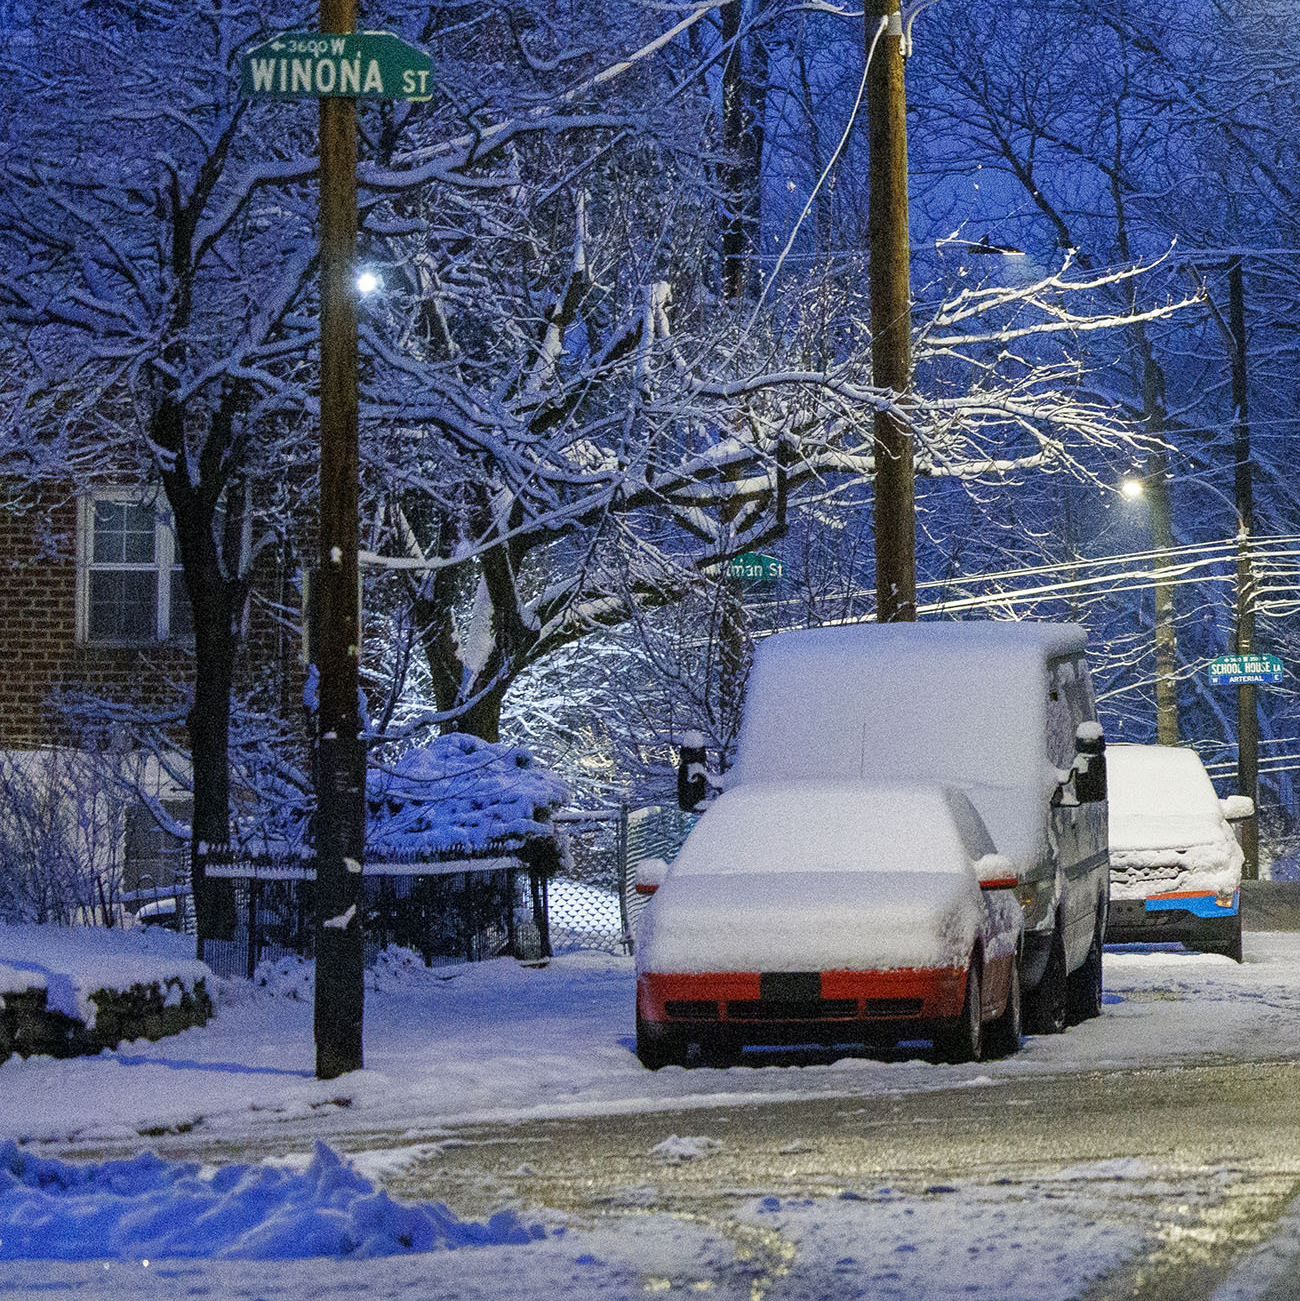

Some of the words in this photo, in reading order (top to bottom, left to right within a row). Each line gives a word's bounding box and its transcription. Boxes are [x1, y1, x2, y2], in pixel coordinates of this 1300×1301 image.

[330, 38, 346, 56] W
[250, 58, 384, 93] WINONA
[402, 70, 430, 93] ST
[769, 563, 783, 577] St
[1211, 663, 1242, 674] SCHOOL
[1244, 662, 1271, 673] HOUSE
[1229, 675, 1264, 683] ARTERIAL
